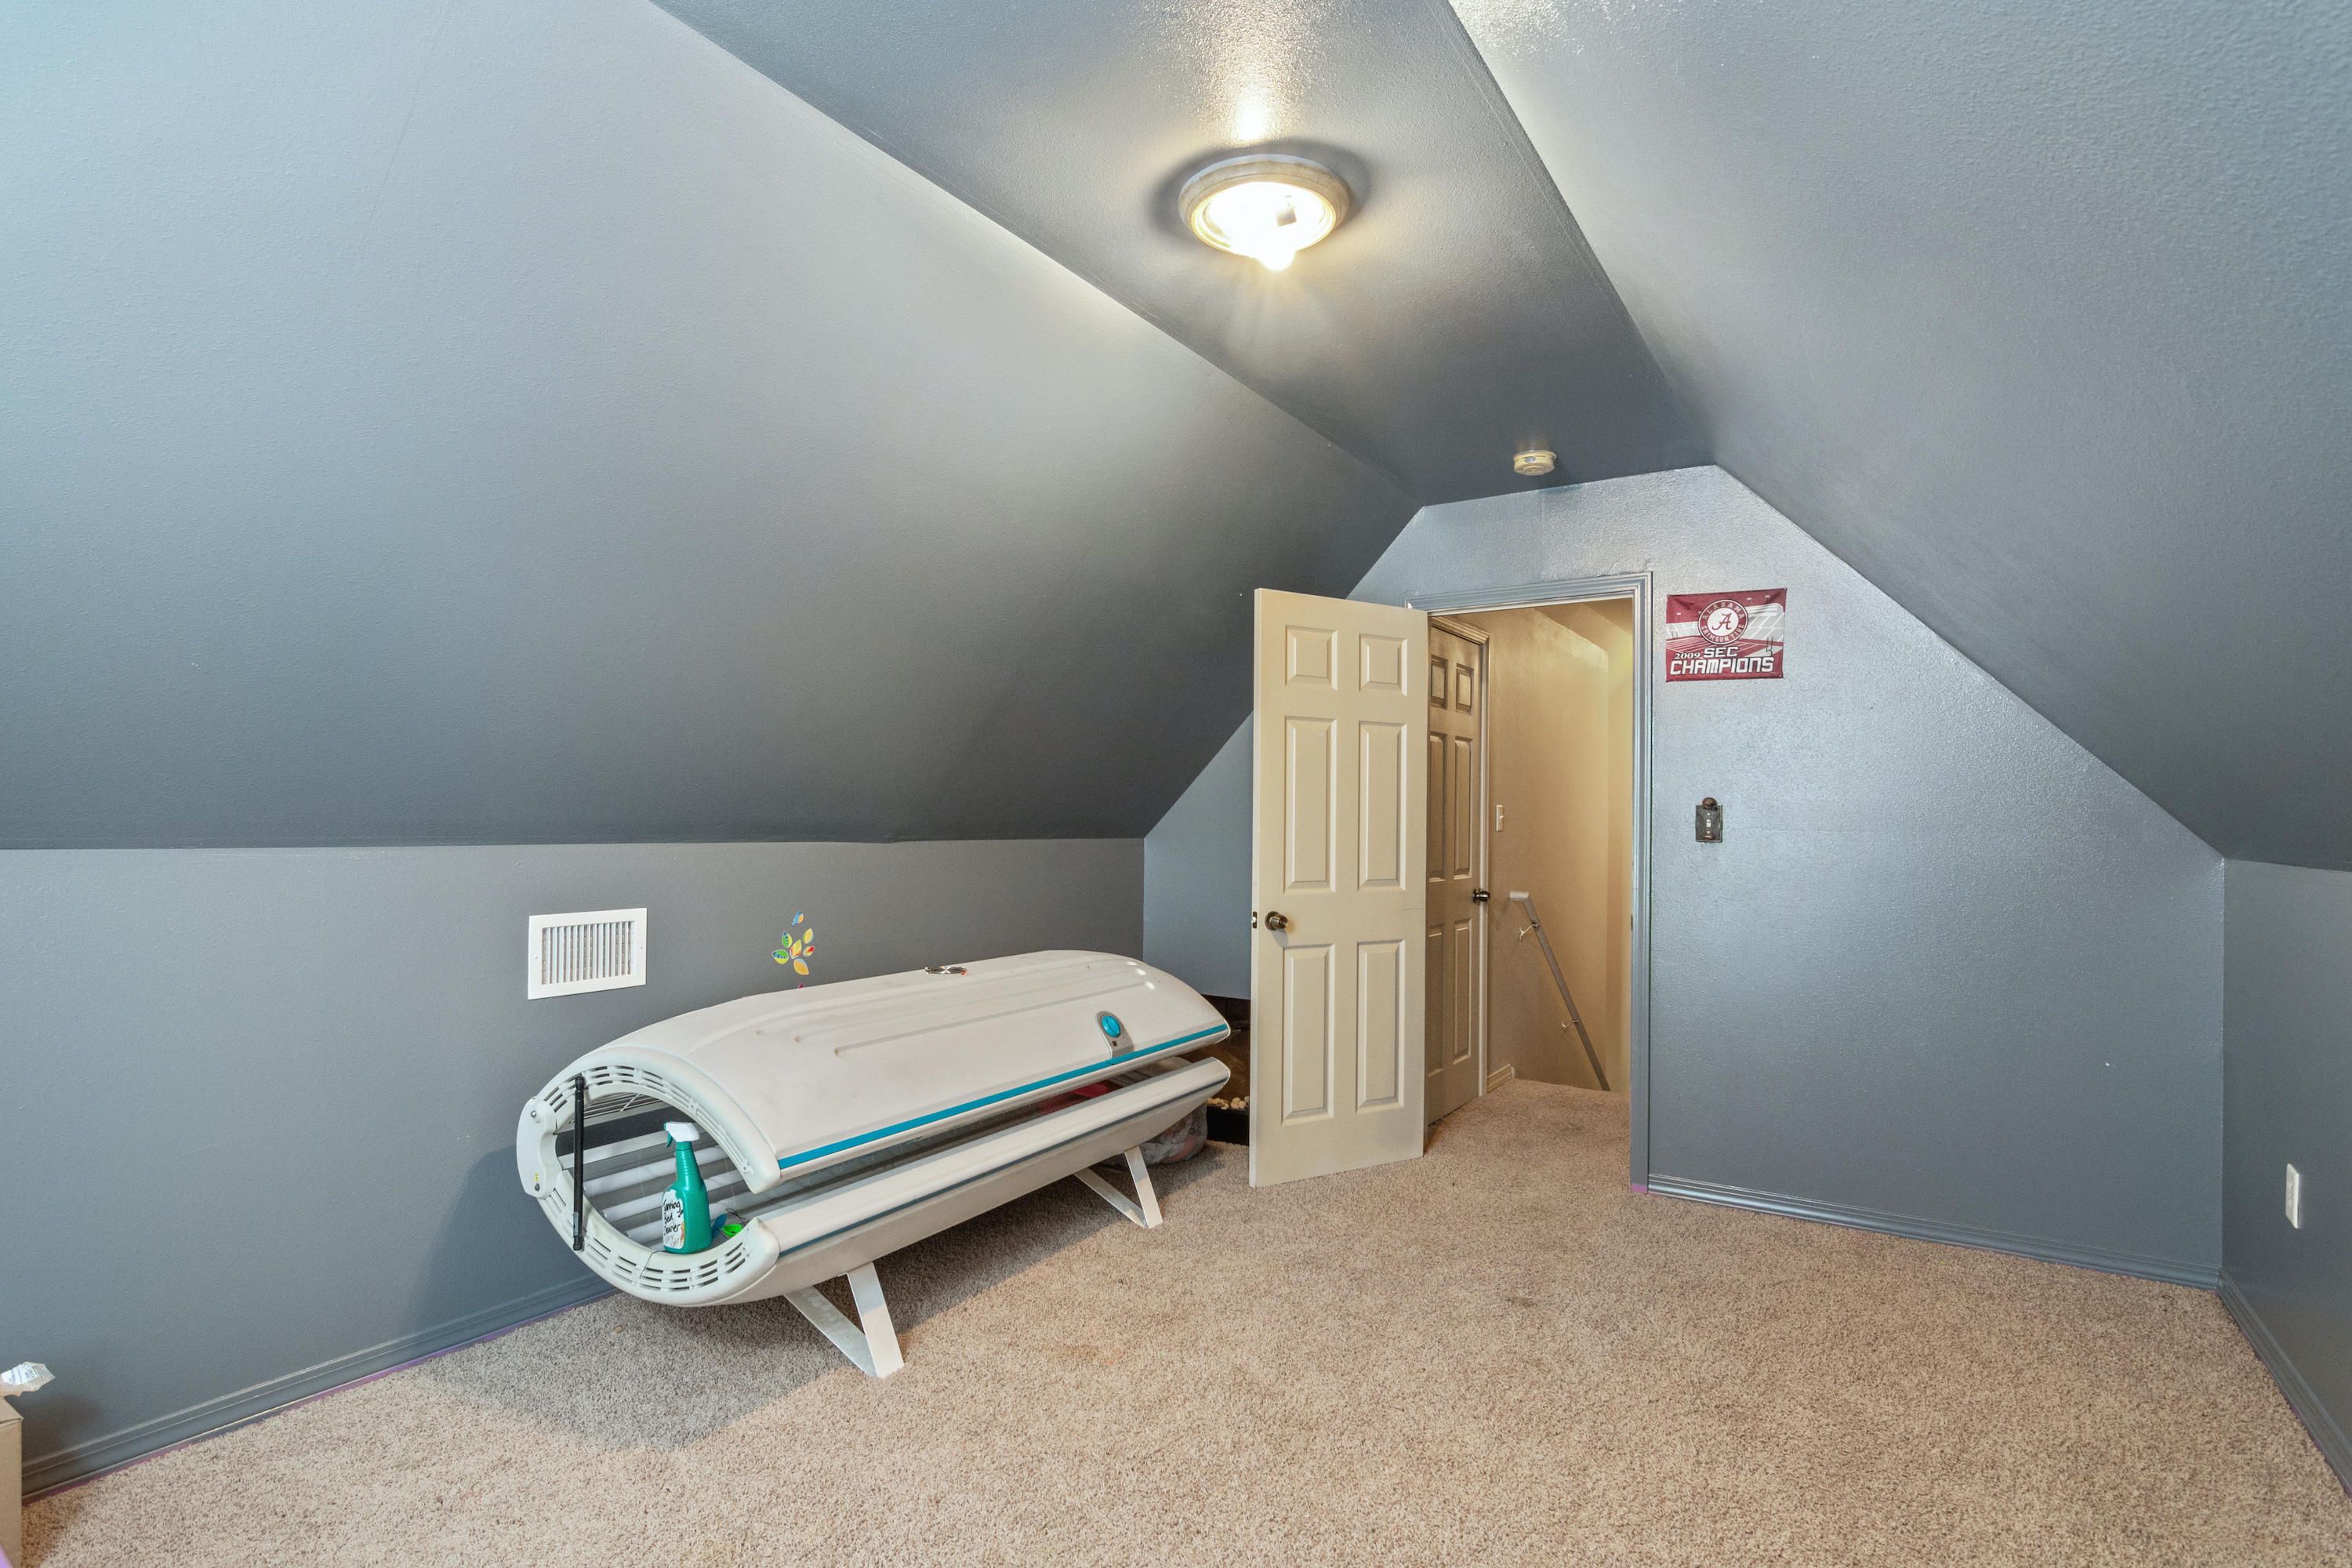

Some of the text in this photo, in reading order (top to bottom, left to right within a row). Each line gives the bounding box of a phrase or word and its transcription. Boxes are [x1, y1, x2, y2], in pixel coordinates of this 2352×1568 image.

[1702, 601, 1745, 620] ALABAMA
[1711, 612, 1733, 630] A
[1701, 623, 1745, 642] CRIMSON TIDE
[1704, 646, 1739, 658] SEC
[1670, 657, 1774, 675] CHAMPIONS
